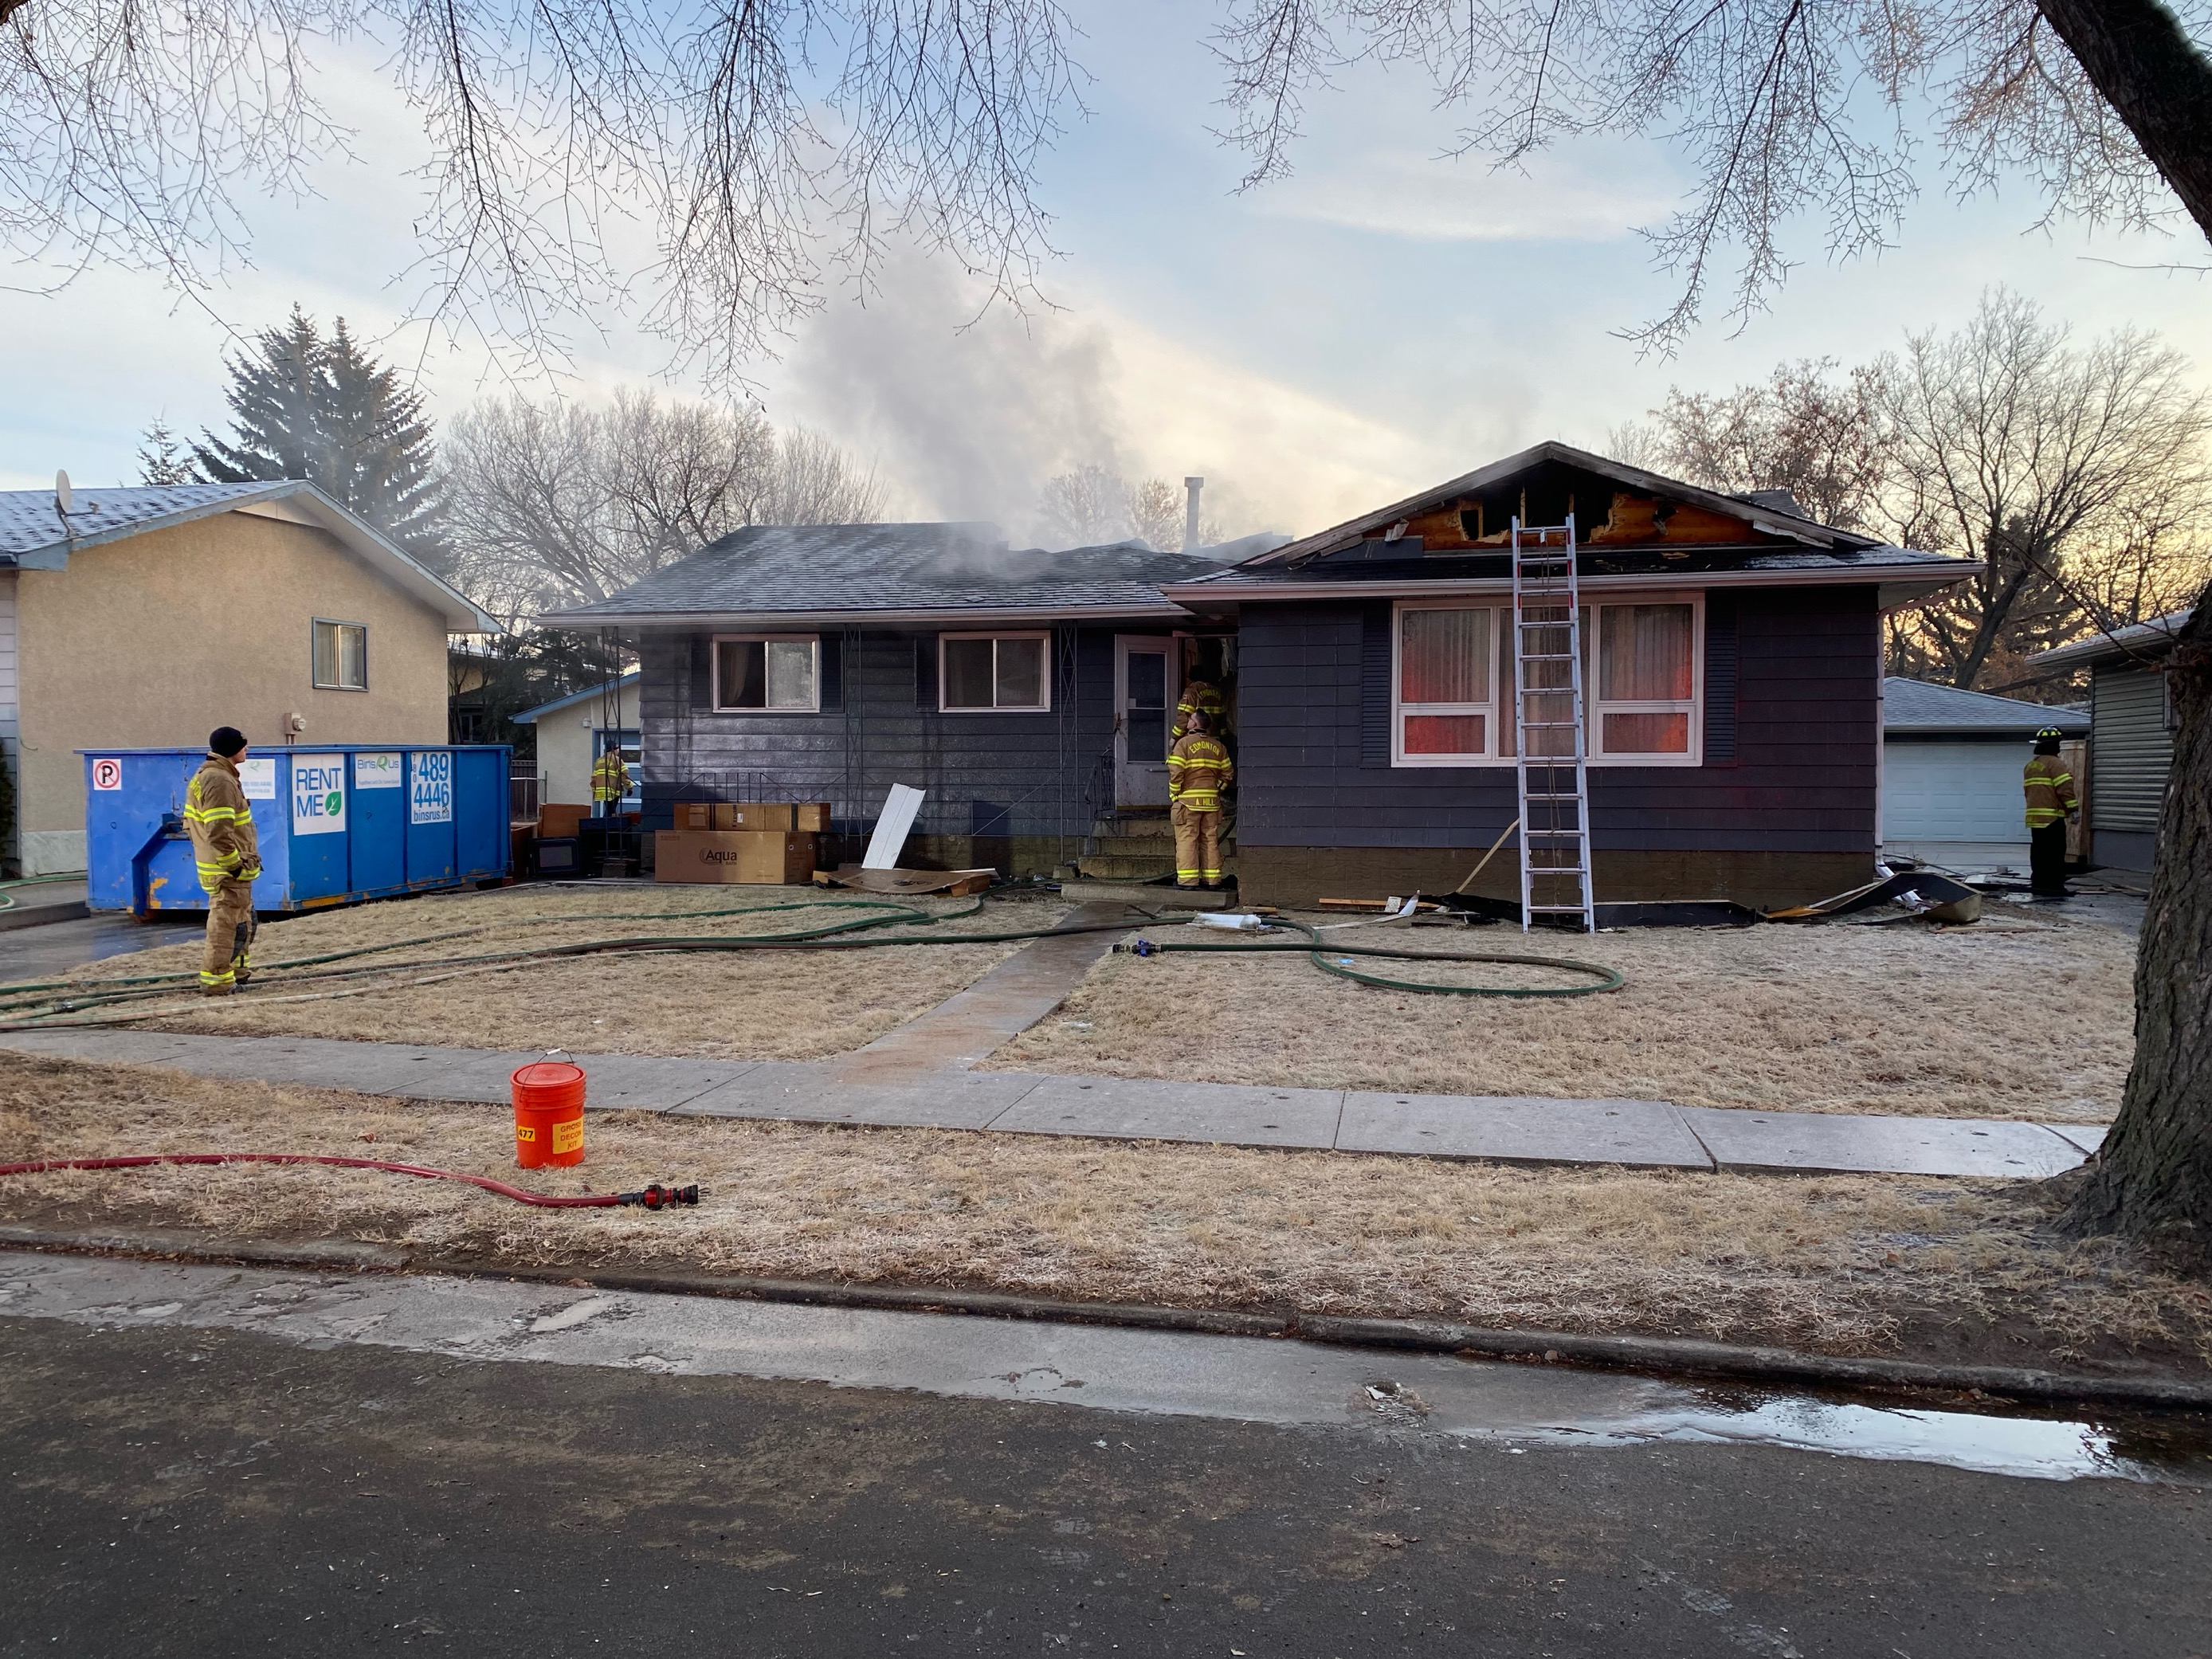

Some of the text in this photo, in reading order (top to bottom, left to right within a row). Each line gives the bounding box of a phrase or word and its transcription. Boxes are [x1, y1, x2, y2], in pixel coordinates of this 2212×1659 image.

[1189, 741, 1220, 755] EDMONTON
[418, 753, 449, 782] 489
[296, 768, 341, 791] RENT
[414, 782, 449, 808] 4446
[296, 794, 324, 818] ME
[414, 809, 449, 822] binsrus.ca
[706, 849, 737, 863] Aqua
[560, 1121, 581, 1132] GROSS
[518, 1129, 534, 1139] 477
[560, 1131, 581, 1141] DECON
[567, 1141, 578, 1150] KIT
